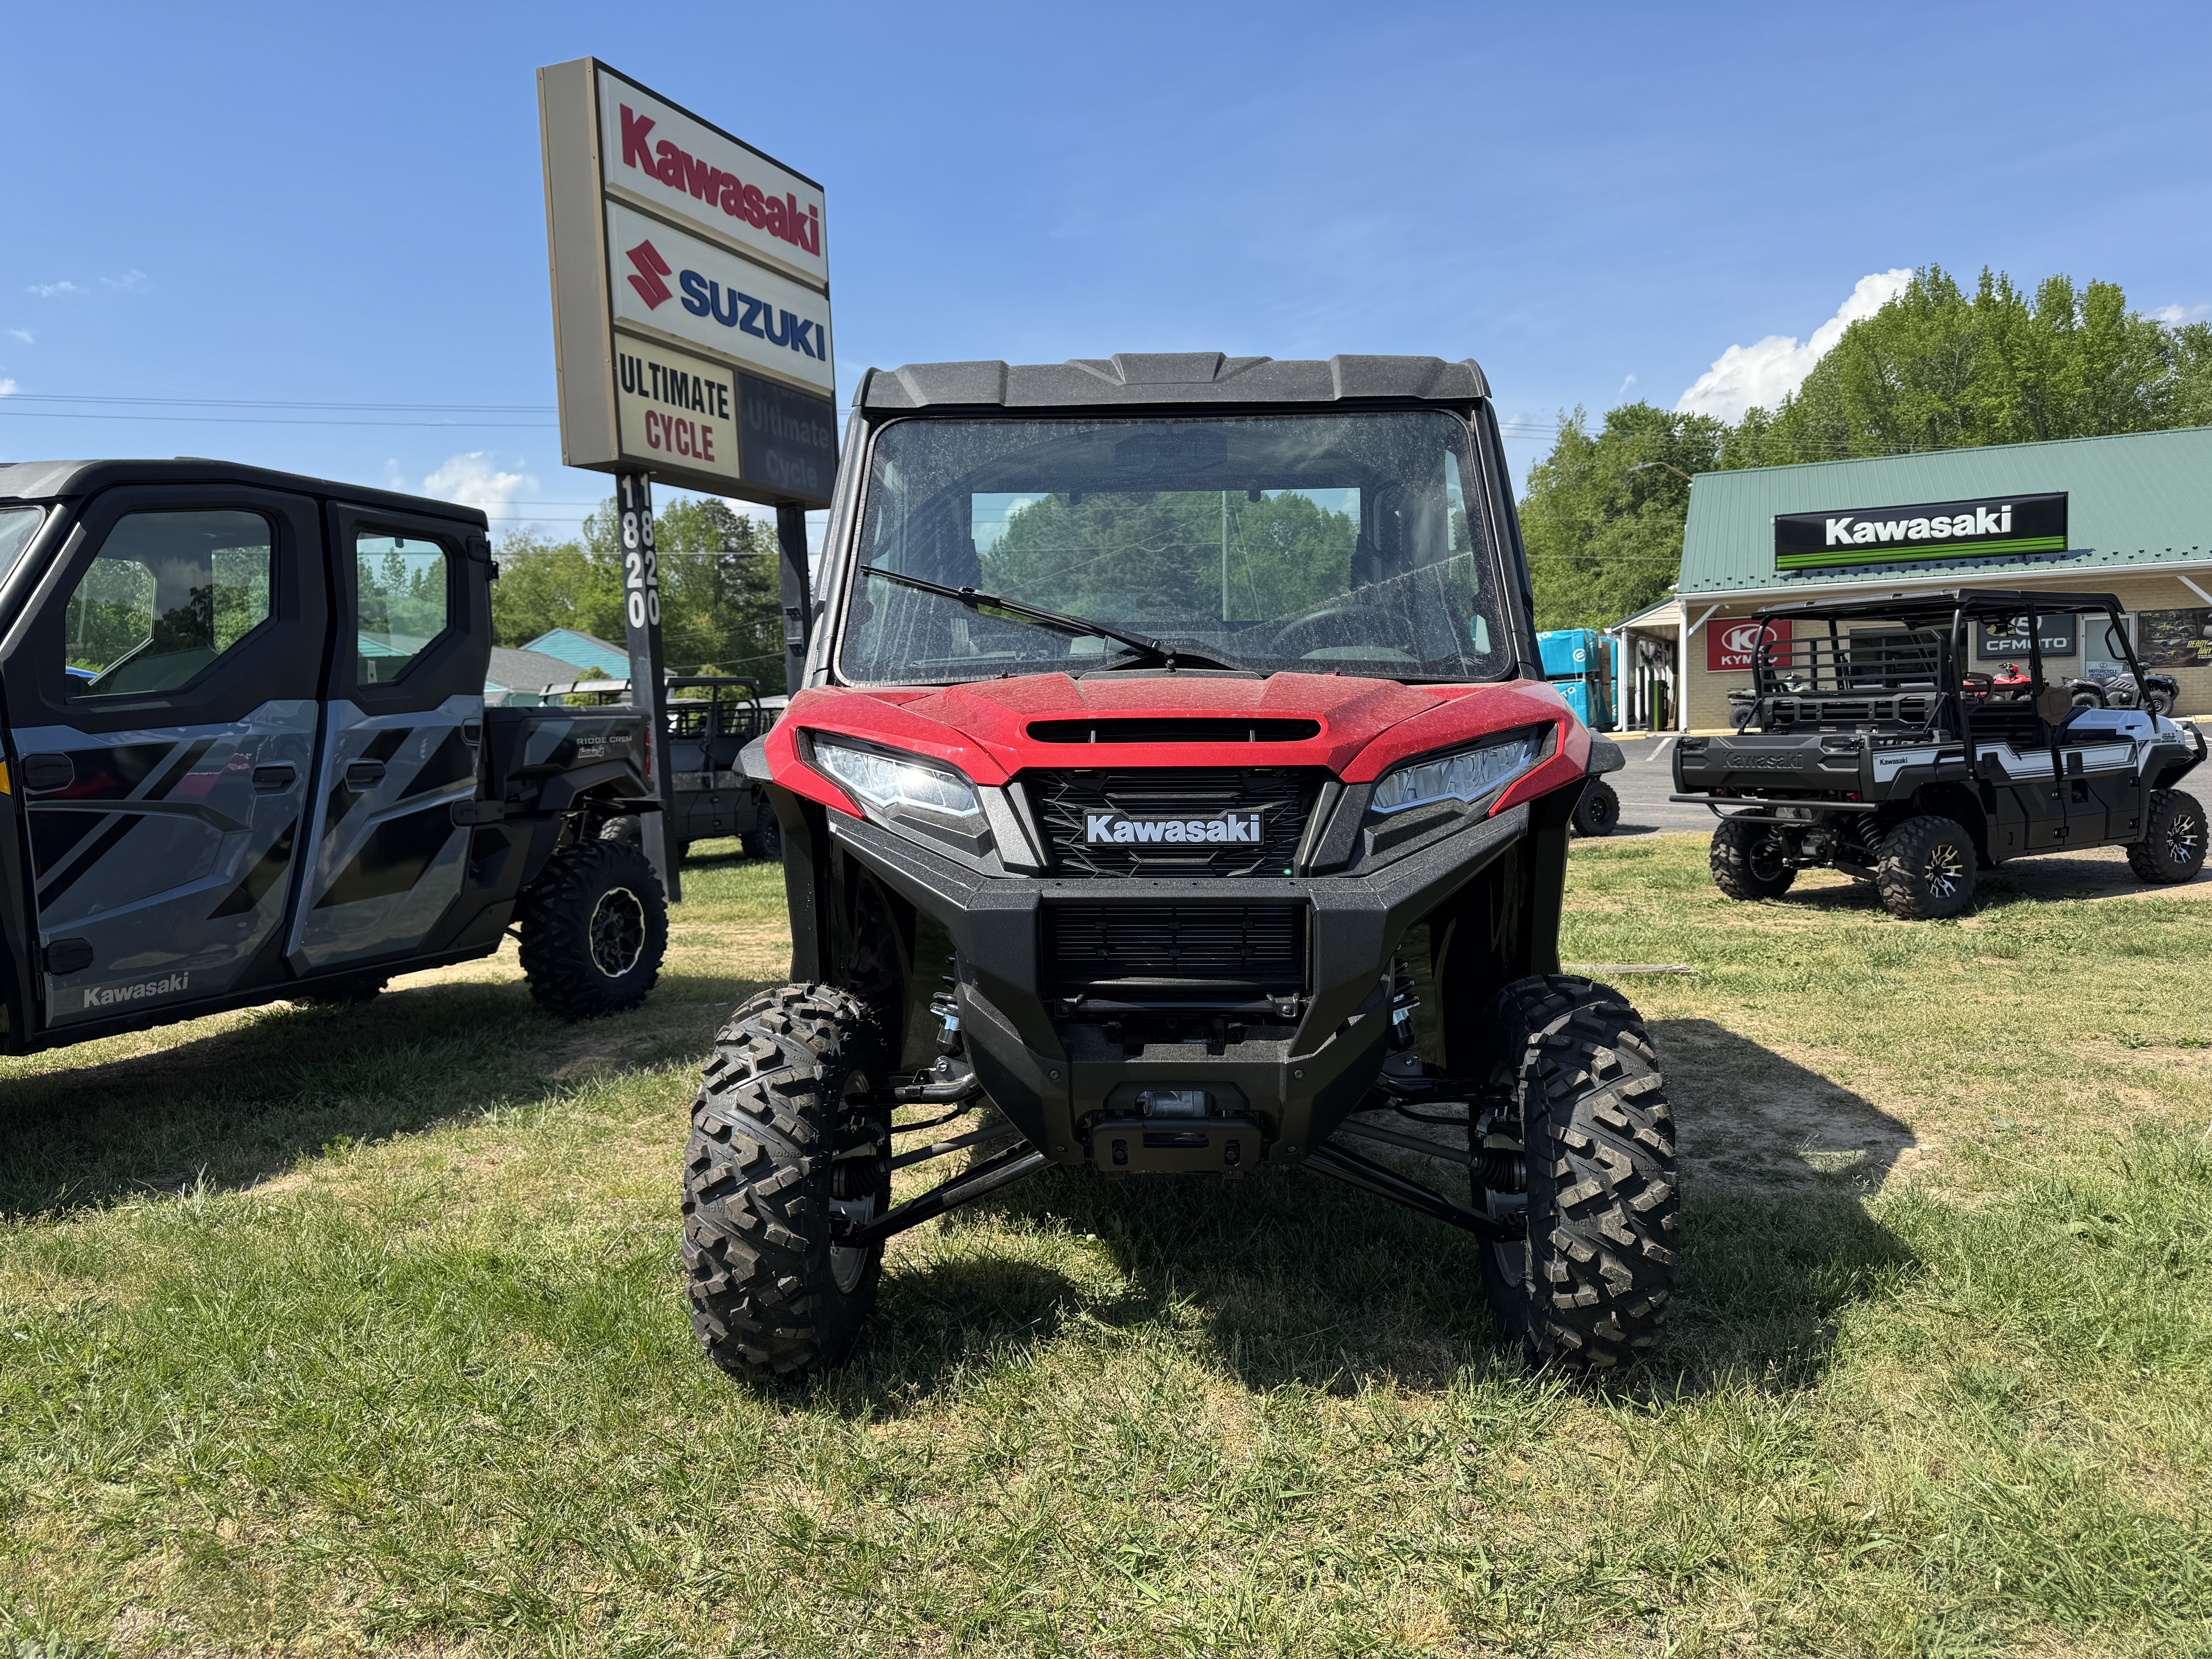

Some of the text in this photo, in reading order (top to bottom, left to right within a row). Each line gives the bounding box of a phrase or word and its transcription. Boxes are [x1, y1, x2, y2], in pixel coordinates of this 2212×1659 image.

[620, 102, 820, 257] Kawasaki
[679, 269, 826, 362] SUZUKI
[620, 353, 730, 420] ULTIMATE
[645, 410, 715, 462] CYCLE
[748, 398, 829, 449] Ultimate
[765, 448, 817, 489] Cycle
[1826, 505, 2012, 546] Kawasaki
[622, 475, 645, 629] 1820
[640, 472, 660, 626] 1820
[1721, 654, 1778, 665] KYM
[2187, 639, 2209, 648] READY
[1723, 752, 1803, 769] Kawasaki
[1880, 757, 1908, 766] Kawasaki
[1087, 814, 1259, 843] Kawasaki
[84, 971, 189, 1008] Kawasaki
[775, 1150, 803, 1158] DURO
